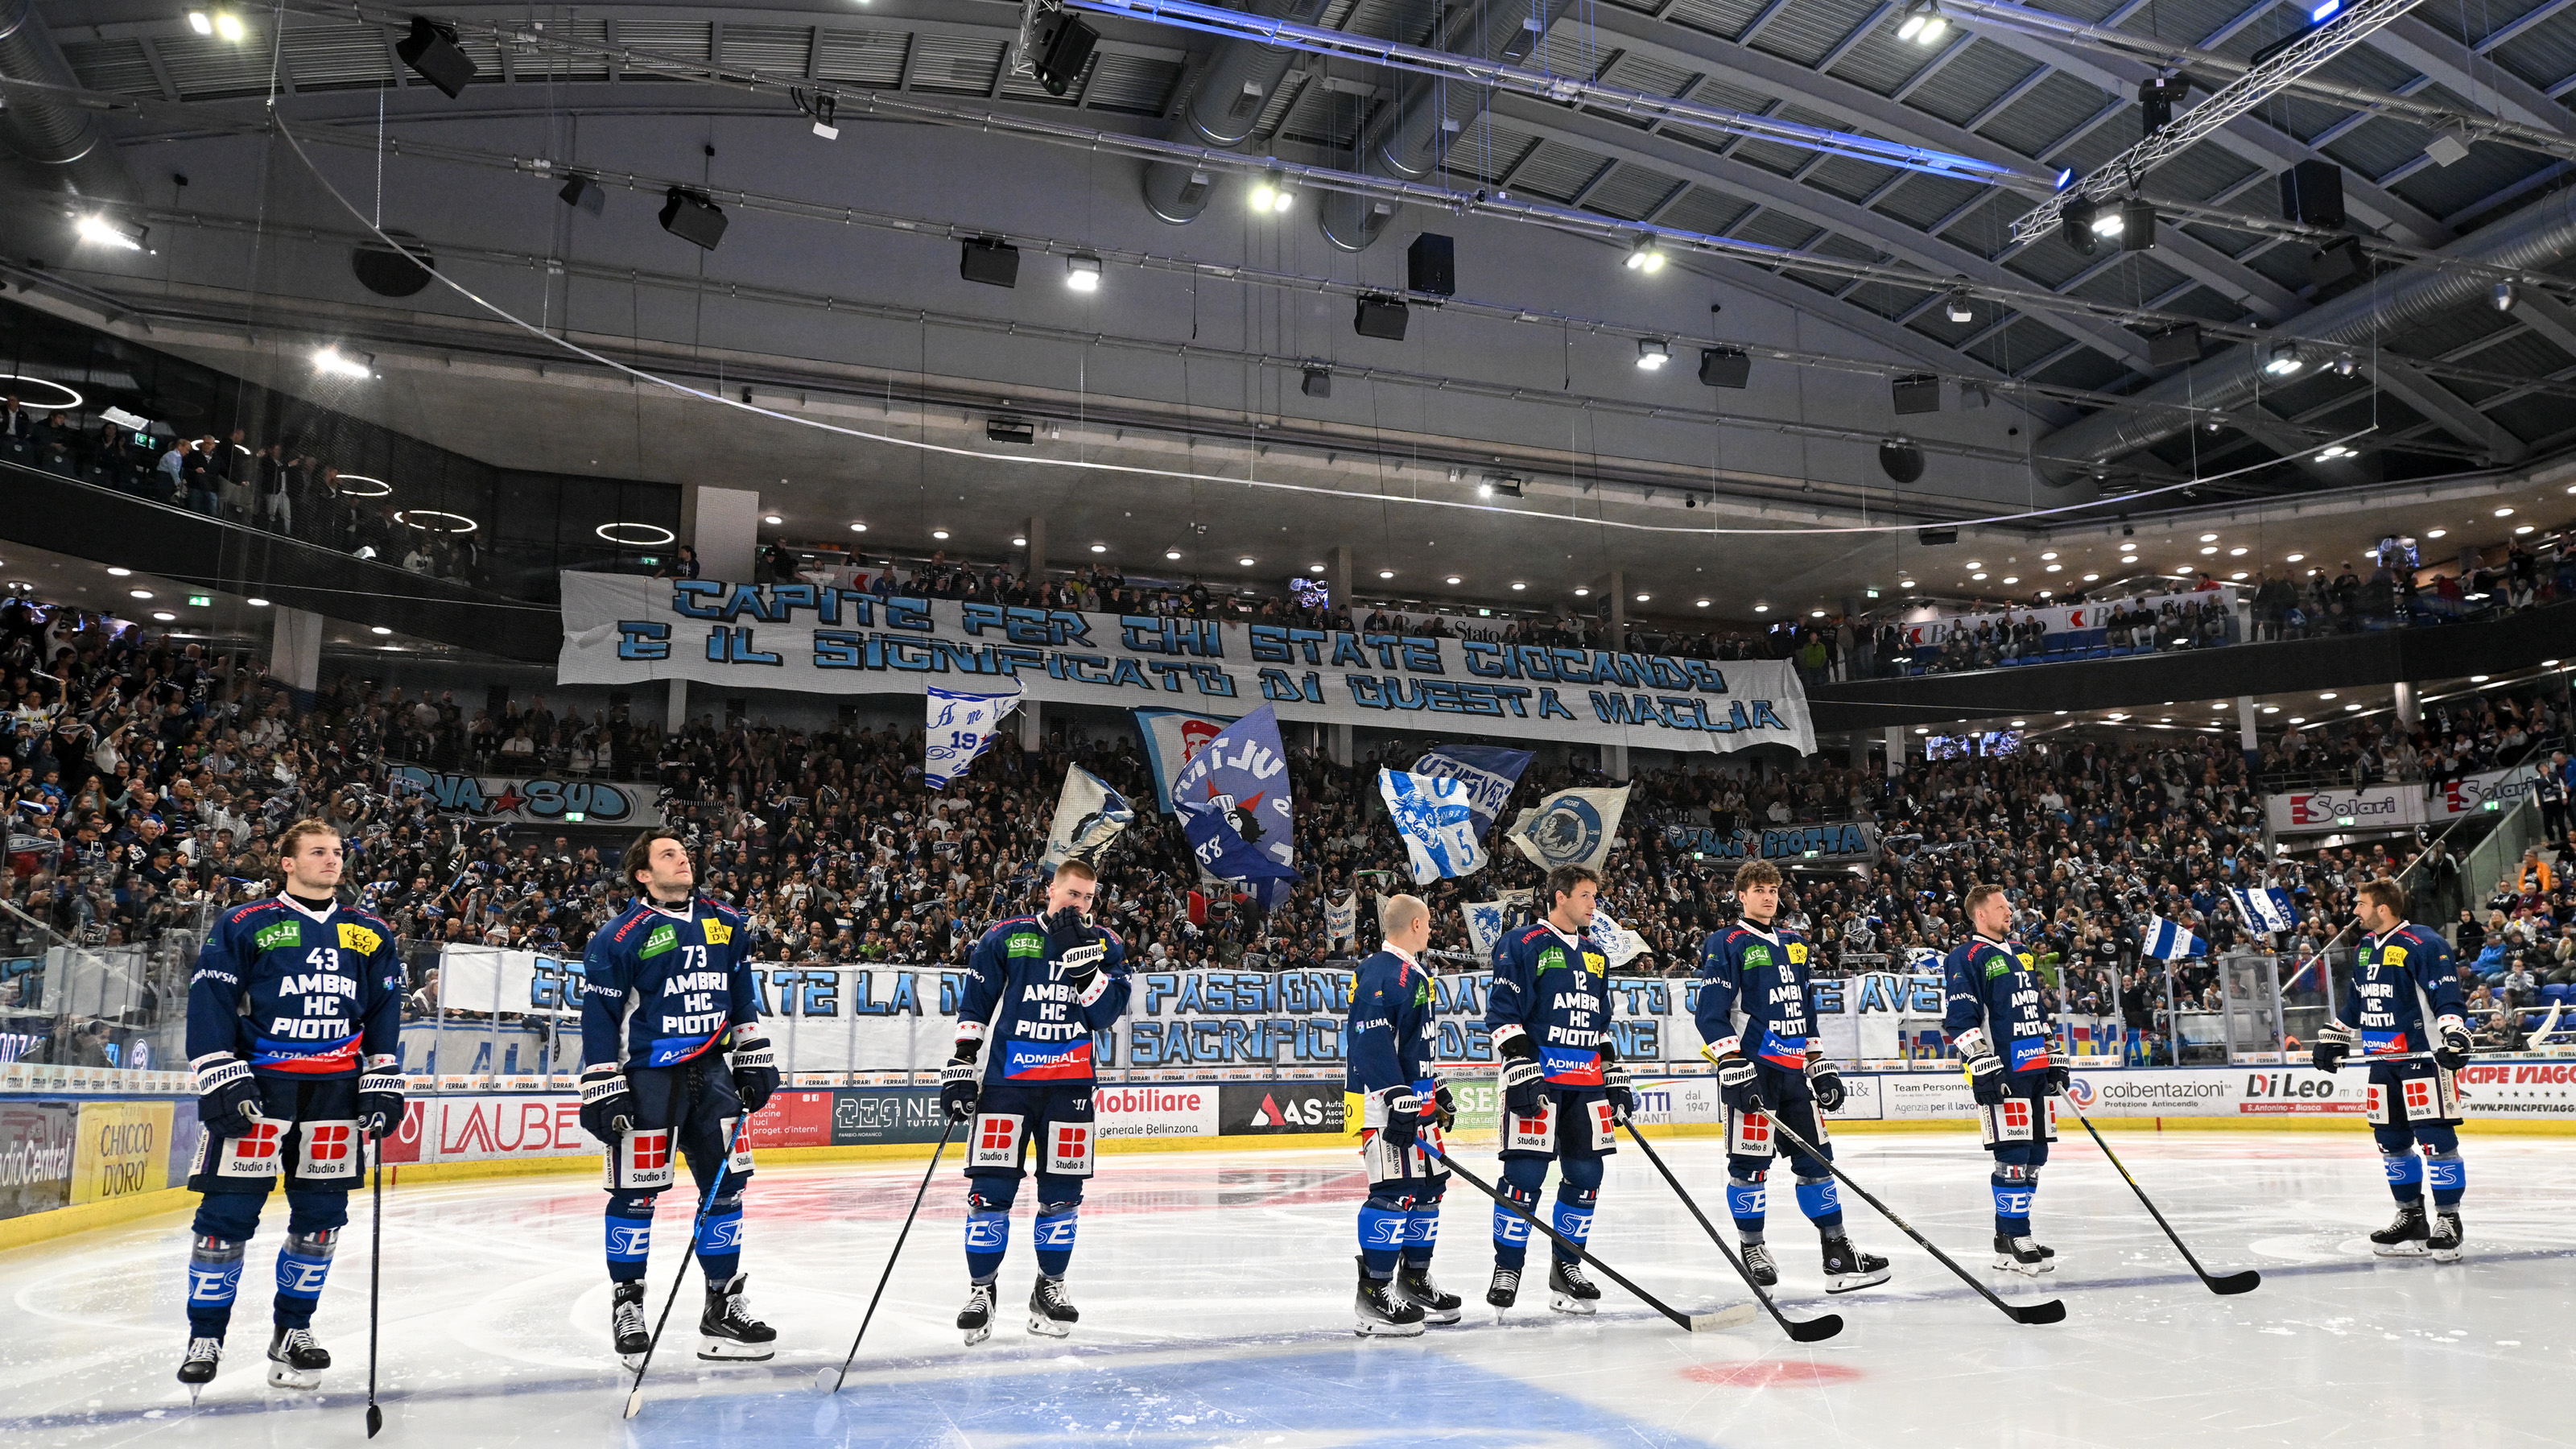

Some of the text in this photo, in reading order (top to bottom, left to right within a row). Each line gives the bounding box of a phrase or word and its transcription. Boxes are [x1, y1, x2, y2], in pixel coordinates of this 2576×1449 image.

[673, 580, 934, 633] CAPITE
[962, 601, 1097, 647] PER
[1121, 614, 1224, 658] CHI
[1250, 624, 1446, 675] STATE
[1455, 620, 1501, 643] Stato
[617, 620, 1790, 733] E IL SIGNIFICATO DI QUESTA MAGLIA
[523, 779, 631, 820] SUD
[306, 947, 340, 971] 43
[682, 945, 708, 969] 73
[1048, 960, 1066, 981] 17
[1778, 964, 1795, 984] 86
[2367, 964, 2380, 980] 27
[279, 974, 357, 1001] AMBRI
[663, 972, 728, 997] AMBRI
[1573, 971, 1587, 990] 12
[2014, 972, 2032, 989] 72
[856, 970, 923, 1017] LA
[2360, 983, 2393, 998] AMBRI
[303, 996, 341, 1016] HC
[683, 993, 713, 1013] HC
[1039, 1003, 1067, 1021] HC
[1553, 993, 1600, 1014] AMBRI
[1784, 1002, 1802, 1018] HC
[2024, 1005, 2039, 1019] HC
[2367, 998, 2383, 1012] HC
[270, 1017, 350, 1039] PIOTTA
[1570, 1010, 1591, 1028] HC
[1015, 1019, 1088, 1041] PIOTTA
[1547, 1025, 1600, 1046] PIOTTA
[1685, 1090, 1701, 1100] dal
[2103, 1081, 2224, 1098] coibentazioni
[1686, 1102, 1710, 1112] 1947
[1895, 1103, 1929, 1113] Agenzia
[1930, 1104, 1946, 1113] per
[1955, 1102, 1979, 1110] lavor
[2152, 1100, 2198, 1108] Antincendio
[440, 1102, 582, 1154] LAUBE
[753, 1125, 818, 1136] proget. d'interni
[1100, 1124, 1198, 1137] generale Bellinzona
[101, 1122, 153, 1158] CHICCO
[1517, 1137, 1546, 1146] Studio B
[1741, 1142, 1761, 1151] Studio
[0, 1137, 72, 1187] dioCentral
[980, 1152, 1009, 1162] Studio B
[1056, 1161, 1084, 1170] Studio B
[232, 1162, 271, 1172] Studio B
[307, 1163, 345, 1174] Studio B
[102, 1161, 146, 1197] D'ORO
[633, 1172, 667, 1182] Studio B
